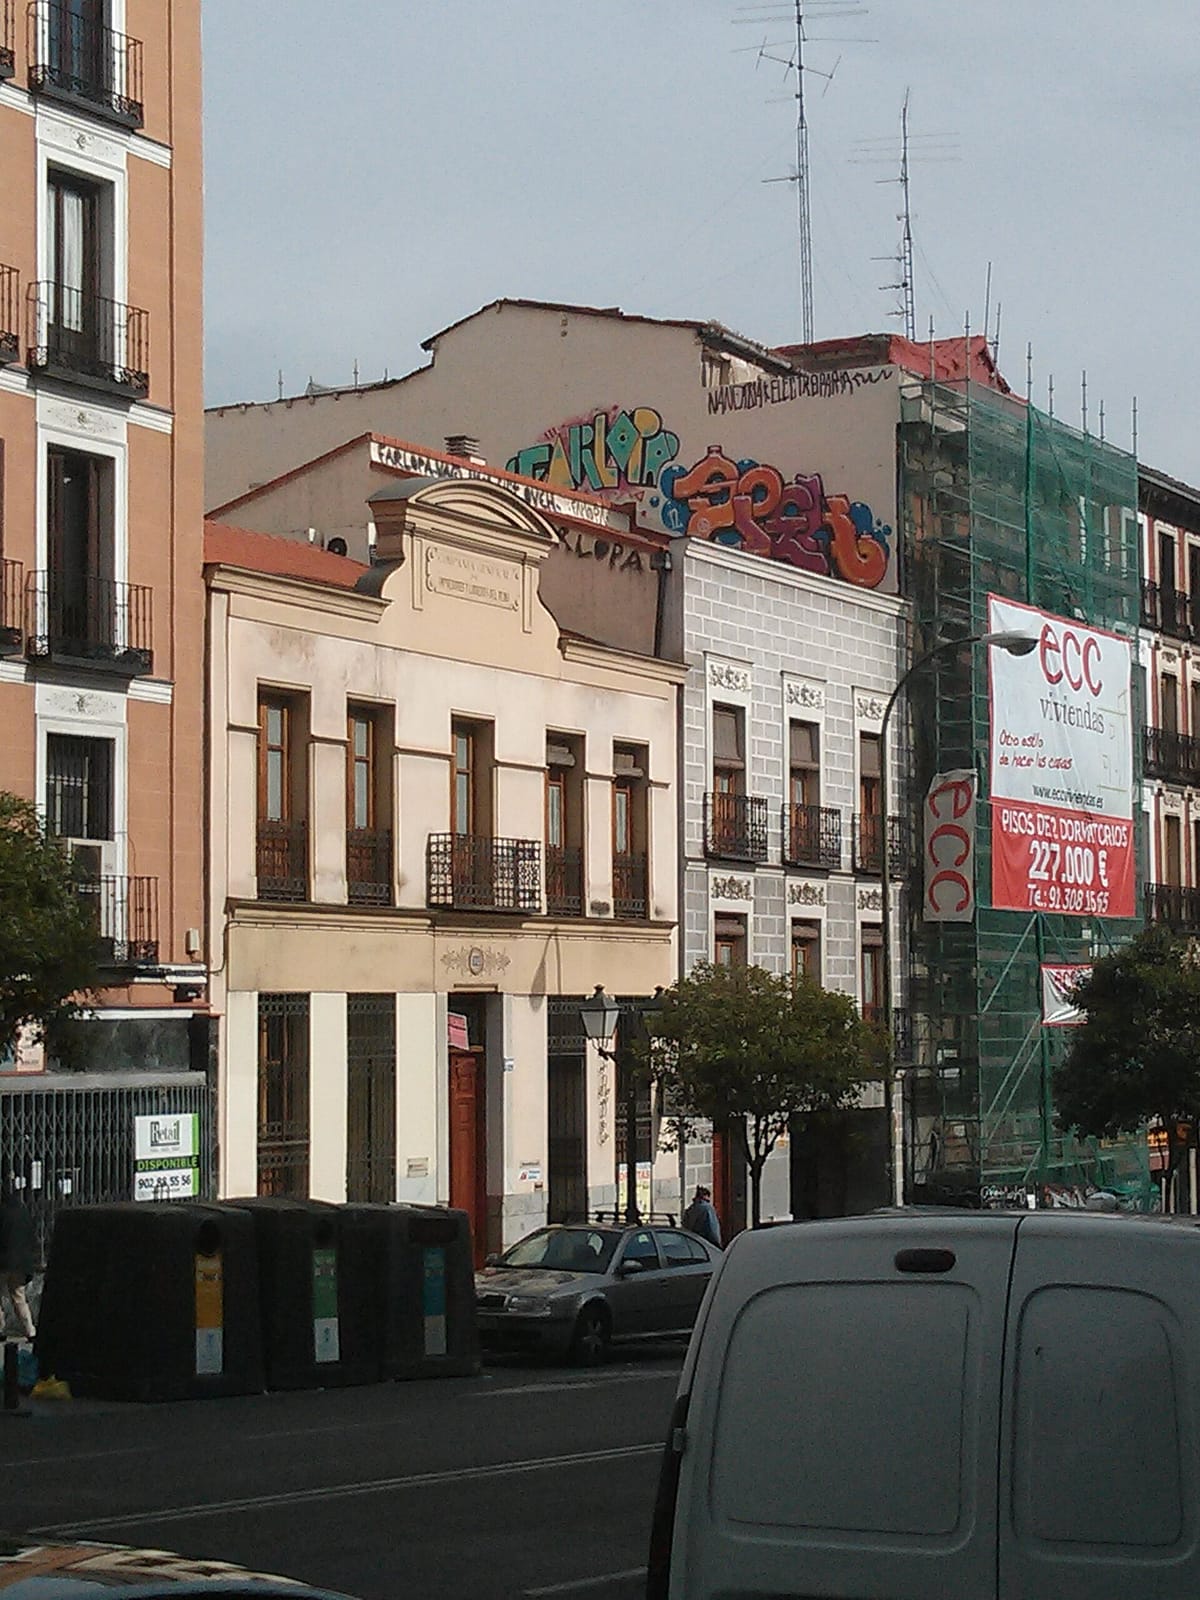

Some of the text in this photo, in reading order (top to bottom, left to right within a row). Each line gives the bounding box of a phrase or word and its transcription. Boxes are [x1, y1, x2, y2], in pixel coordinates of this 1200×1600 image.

[1040, 692, 1105, 734] viviendas
[999, 750, 1009, 766] de
[1002, 809, 1036, 835] PISOS
[1029, 839, 1109, 888] 227.000 €
[1049, 885, 1062, 909] 91
[1062, 888, 1084, 912] 308
[137, 1157, 198, 1171] DISPONIBLE
